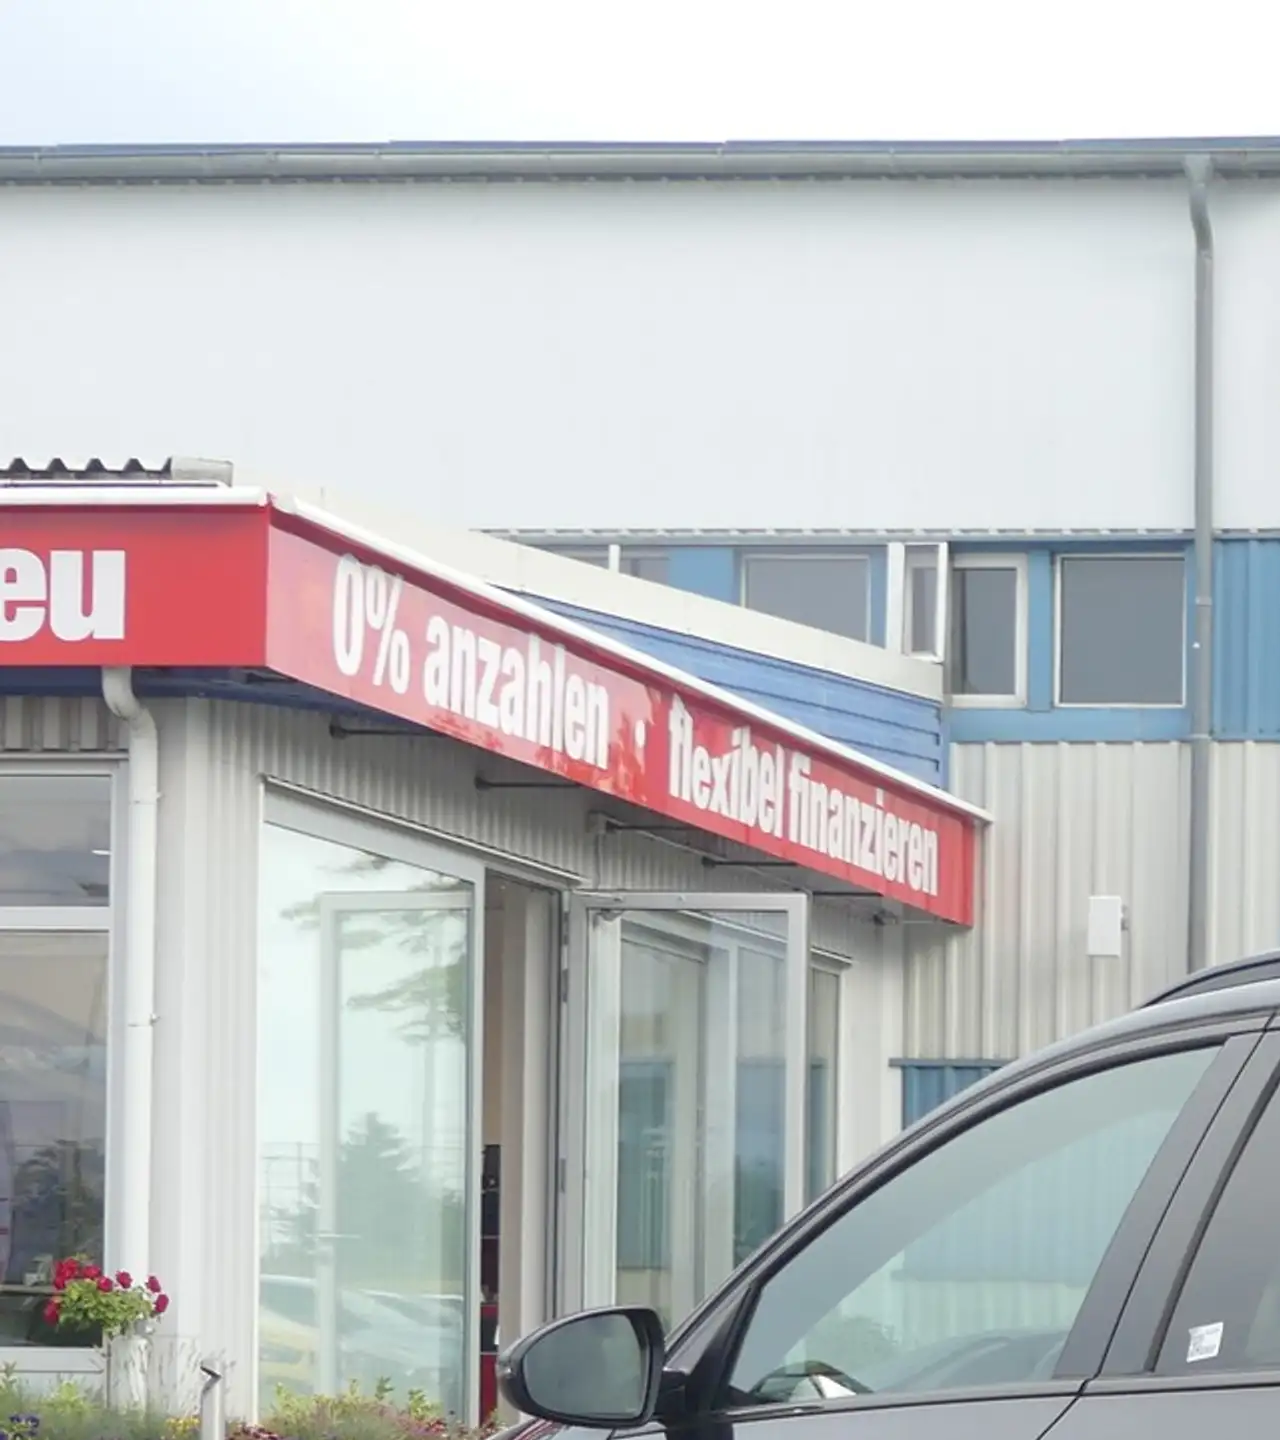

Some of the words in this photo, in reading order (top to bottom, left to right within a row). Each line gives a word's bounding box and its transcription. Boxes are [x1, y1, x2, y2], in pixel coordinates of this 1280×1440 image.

[333, 553, 410, 694] 0%
[423, 615, 609, 770] anzahlen
[669, 694, 783, 839] flexibel
[789, 752, 938, 896] finanzieren
